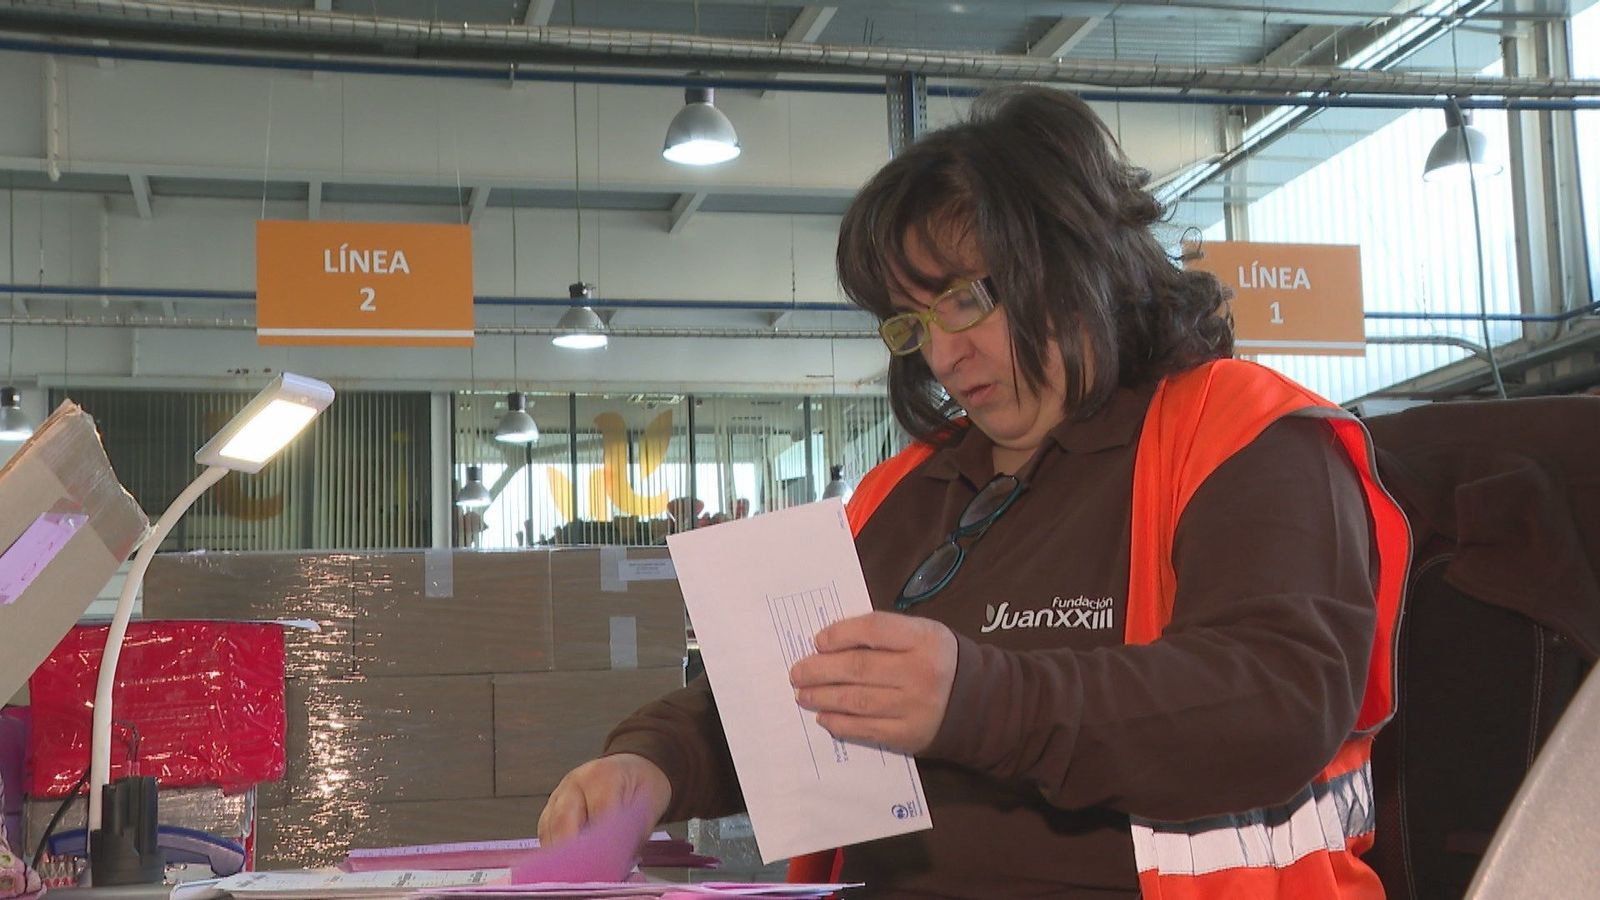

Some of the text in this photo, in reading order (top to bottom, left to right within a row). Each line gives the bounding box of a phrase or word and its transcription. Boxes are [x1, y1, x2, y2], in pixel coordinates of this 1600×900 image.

[324, 243, 410, 273] LÍNEA
[1238, 260, 1311, 289] LÍNEA
[359, 287, 376, 311] 2
[1270, 301, 1284, 324] 1
